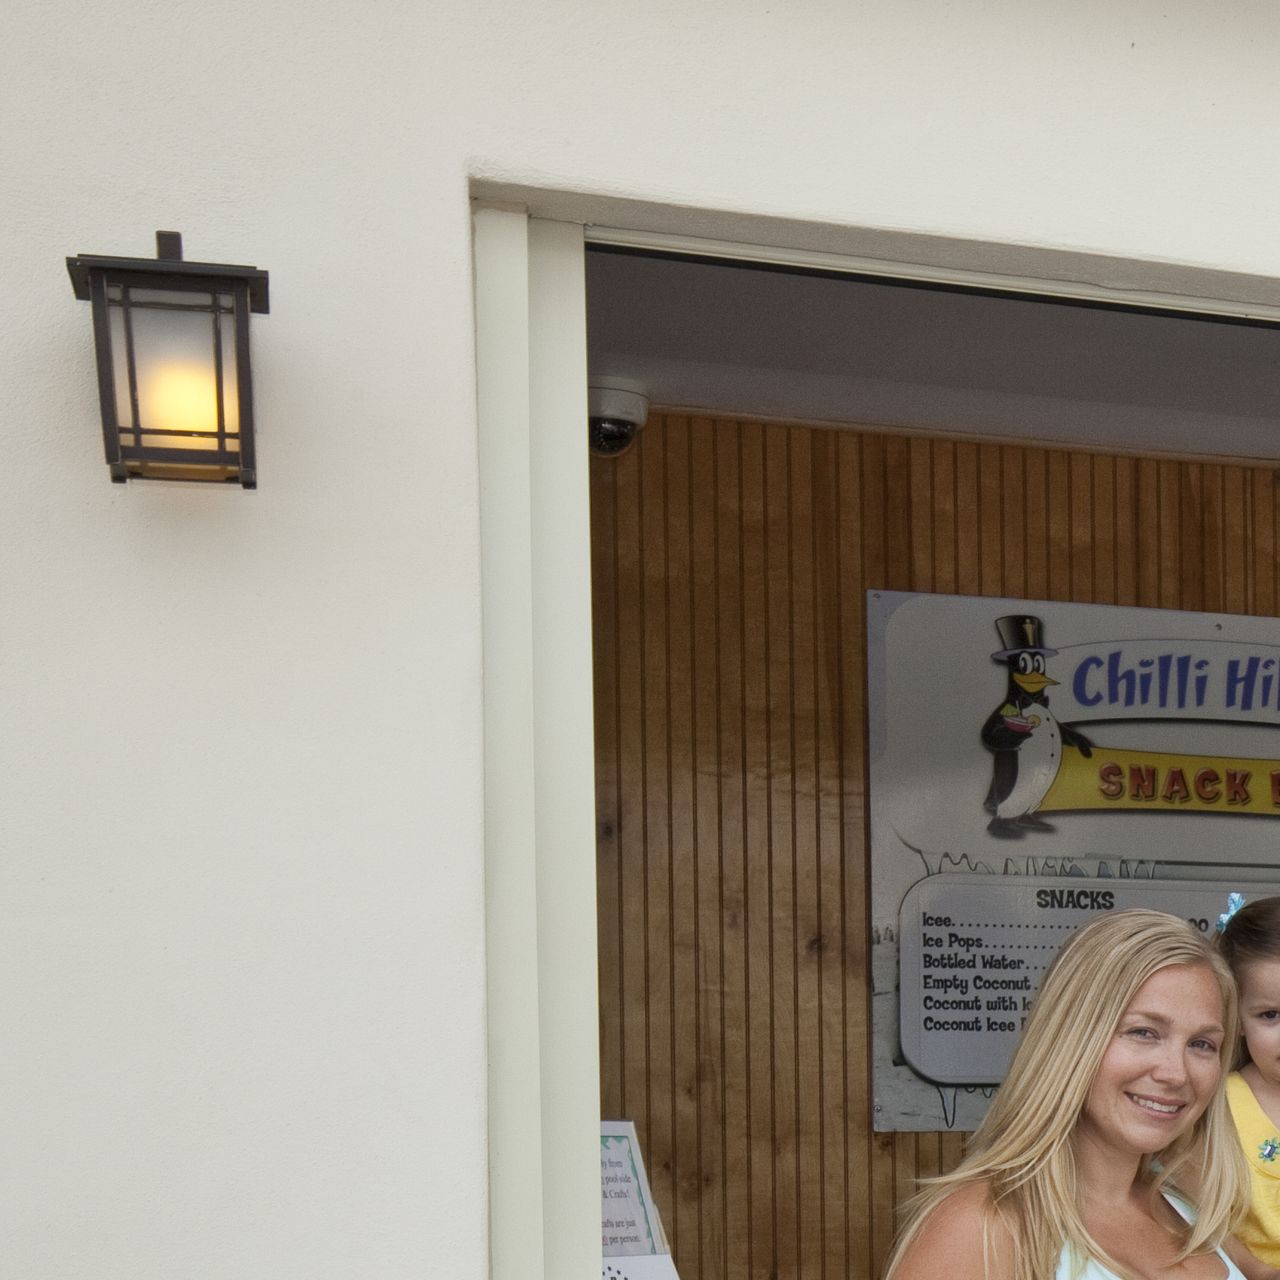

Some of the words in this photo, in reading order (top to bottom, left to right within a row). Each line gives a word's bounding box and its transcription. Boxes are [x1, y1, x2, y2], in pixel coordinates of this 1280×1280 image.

[1072, 651, 1209, 709] Chilli
[1100, 762, 1252, 805] SNACK
[1036, 889, 1115, 910] SNACKS
[923, 933, 943, 947] Ice
[923, 953, 976, 969] Bottled
[923, 975, 969, 994] Empty
[973, 976, 1031, 990] Coconut
[924, 996, 982, 1011] Coconut
[986, 997, 1018, 1011] with
[924, 1016, 982, 1031] Coconut
[986, 1017, 1016, 1031] Icee
